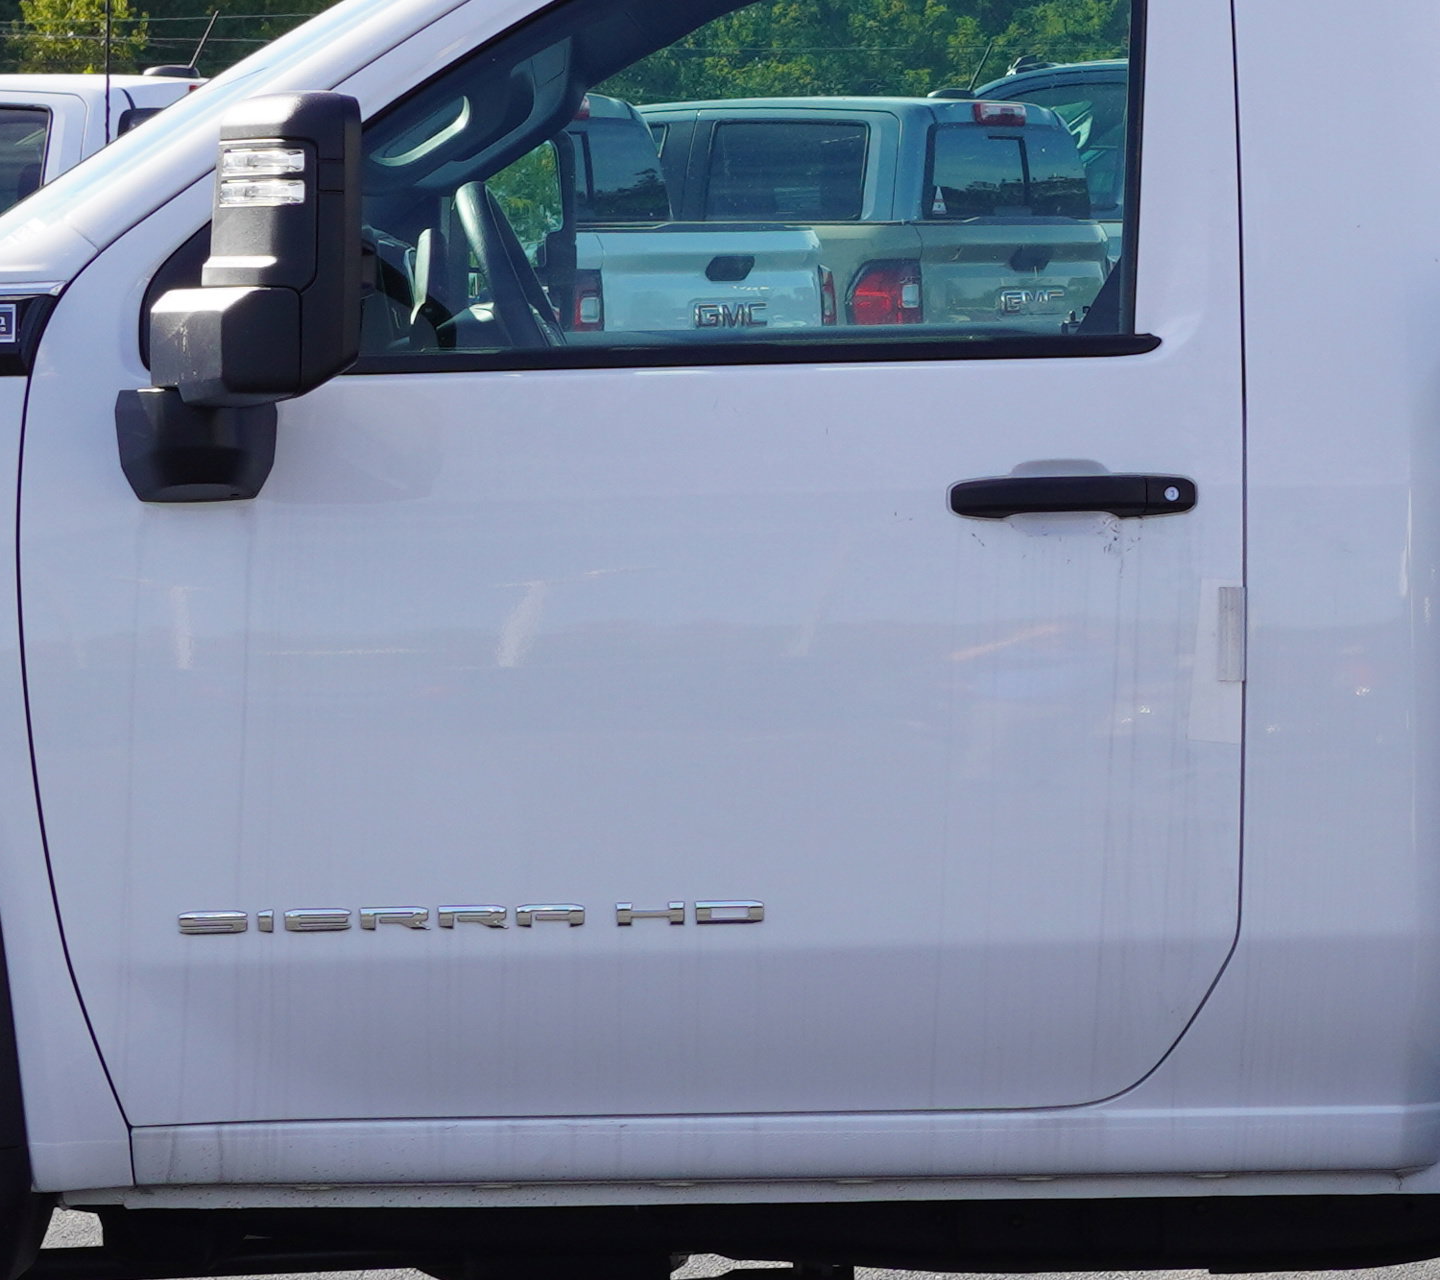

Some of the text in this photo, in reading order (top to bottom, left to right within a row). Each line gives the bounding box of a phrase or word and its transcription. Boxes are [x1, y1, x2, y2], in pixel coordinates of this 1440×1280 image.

[694, 302, 768, 328] GMC
[178, 899, 765, 935] SIERRA HD
